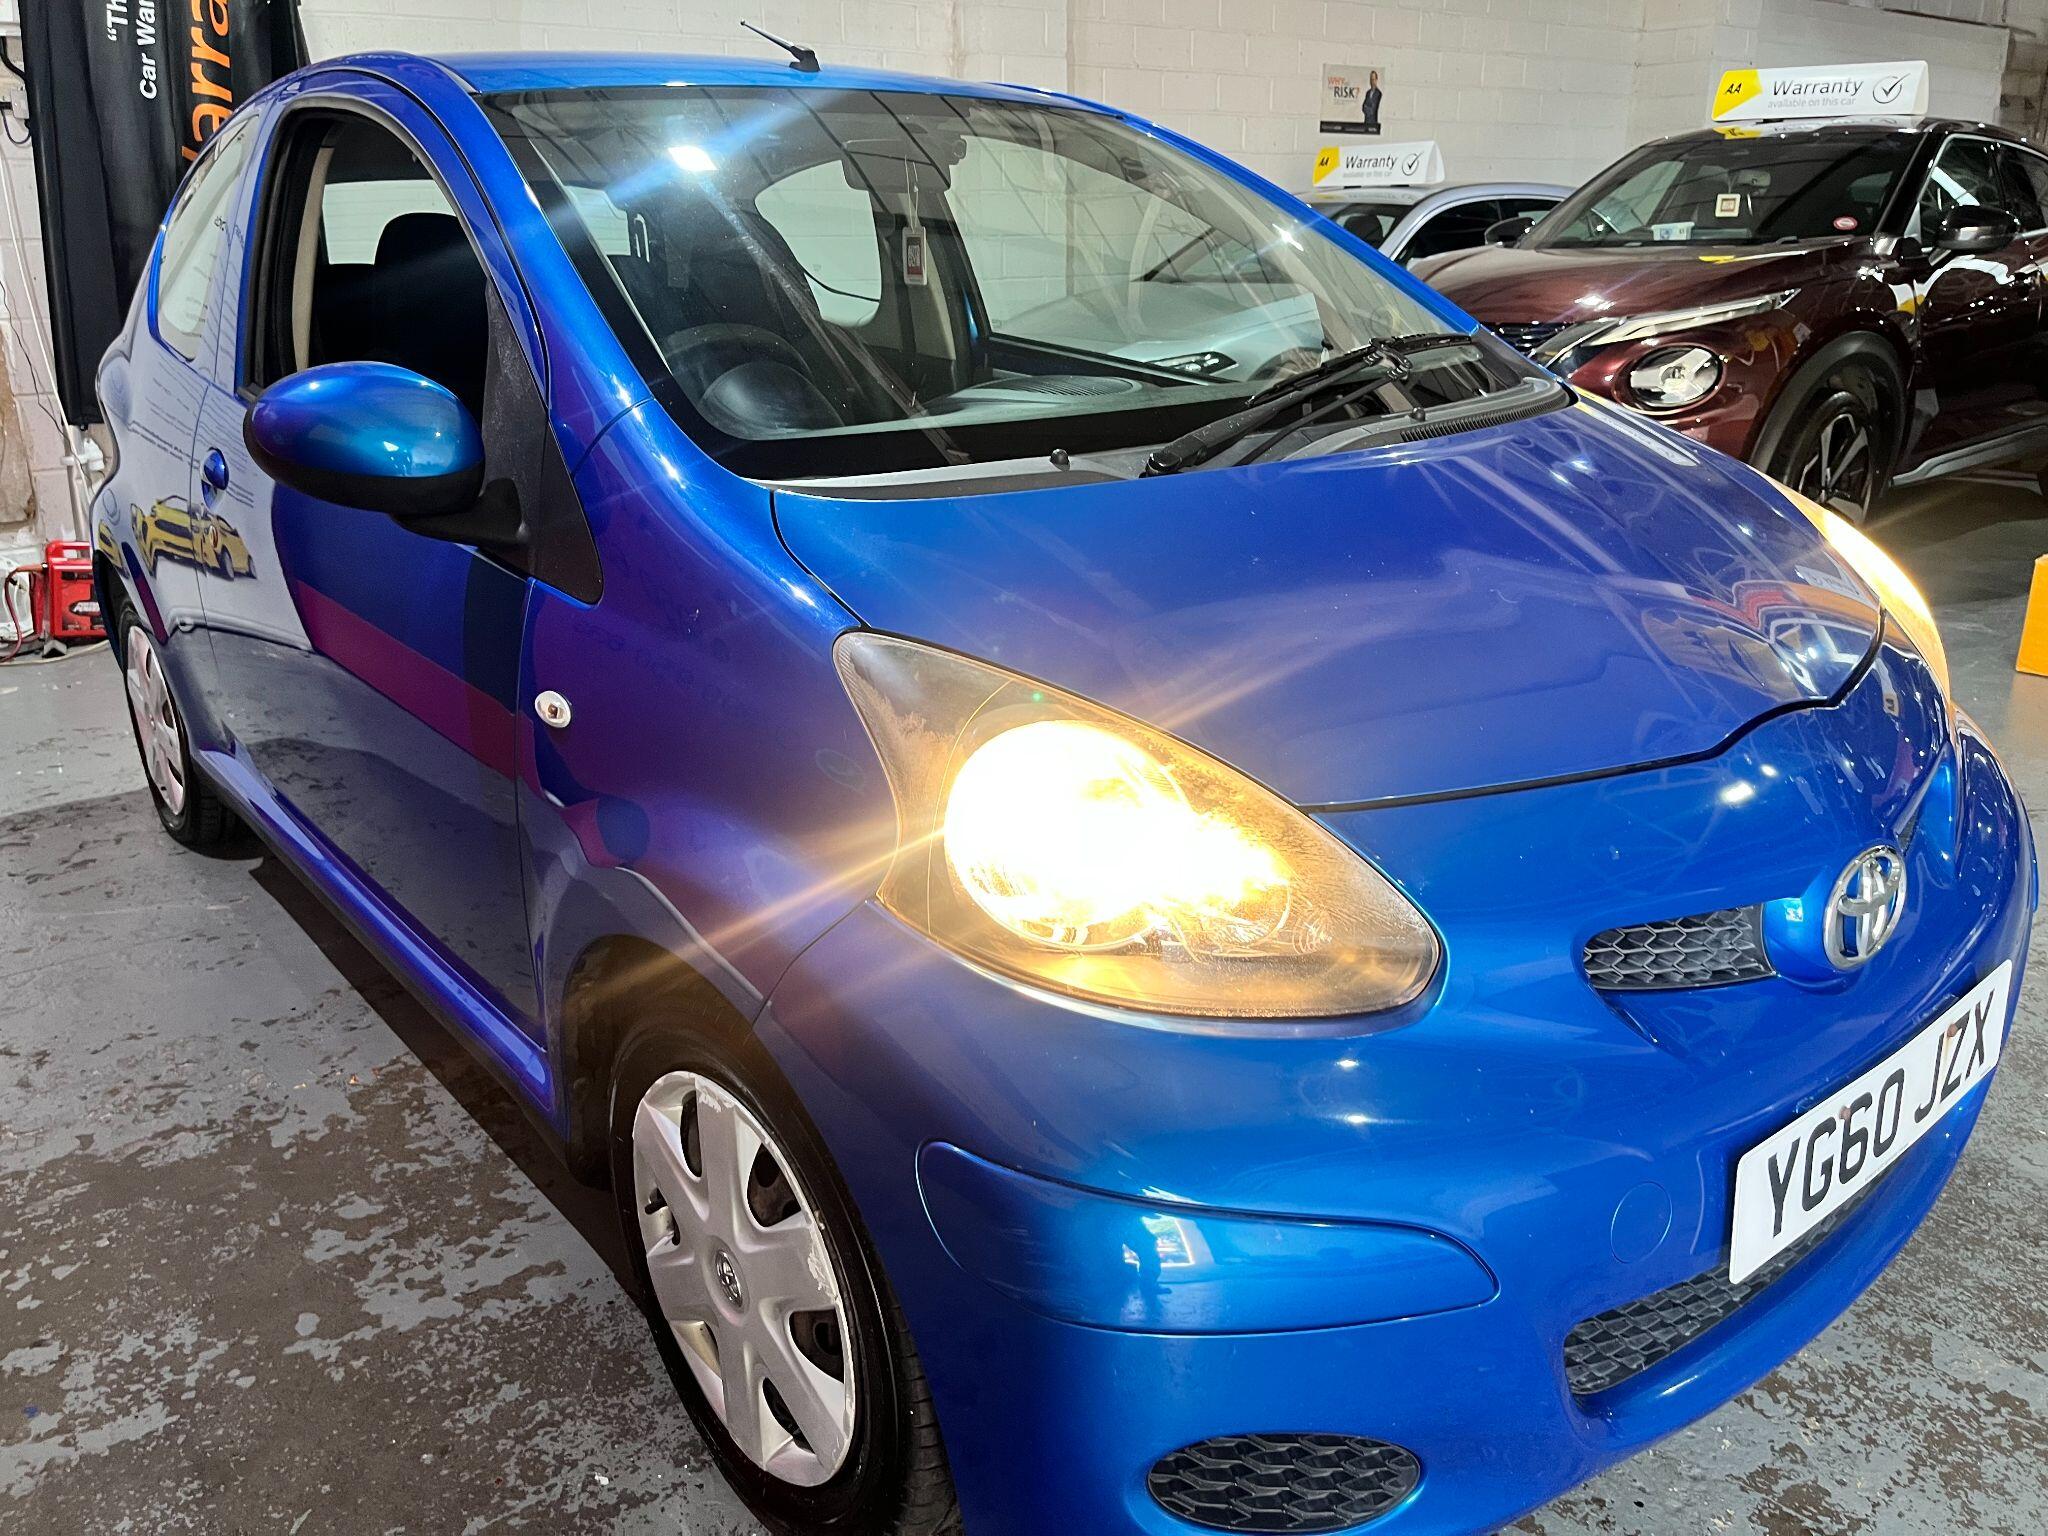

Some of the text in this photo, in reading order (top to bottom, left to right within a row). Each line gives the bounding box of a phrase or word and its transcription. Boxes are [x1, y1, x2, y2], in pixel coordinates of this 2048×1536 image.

[139, 53, 157, 100] Car
[182, 0, 233, 161] arra
[1333, 86, 1360, 99] RISK?
[1725, 83, 1742, 95] AA
[1773, 78, 1864, 97] Warranty
[1345, 154, 1398, 171] Warranty
[1767, 988, 1996, 1239] YG60 JZX
